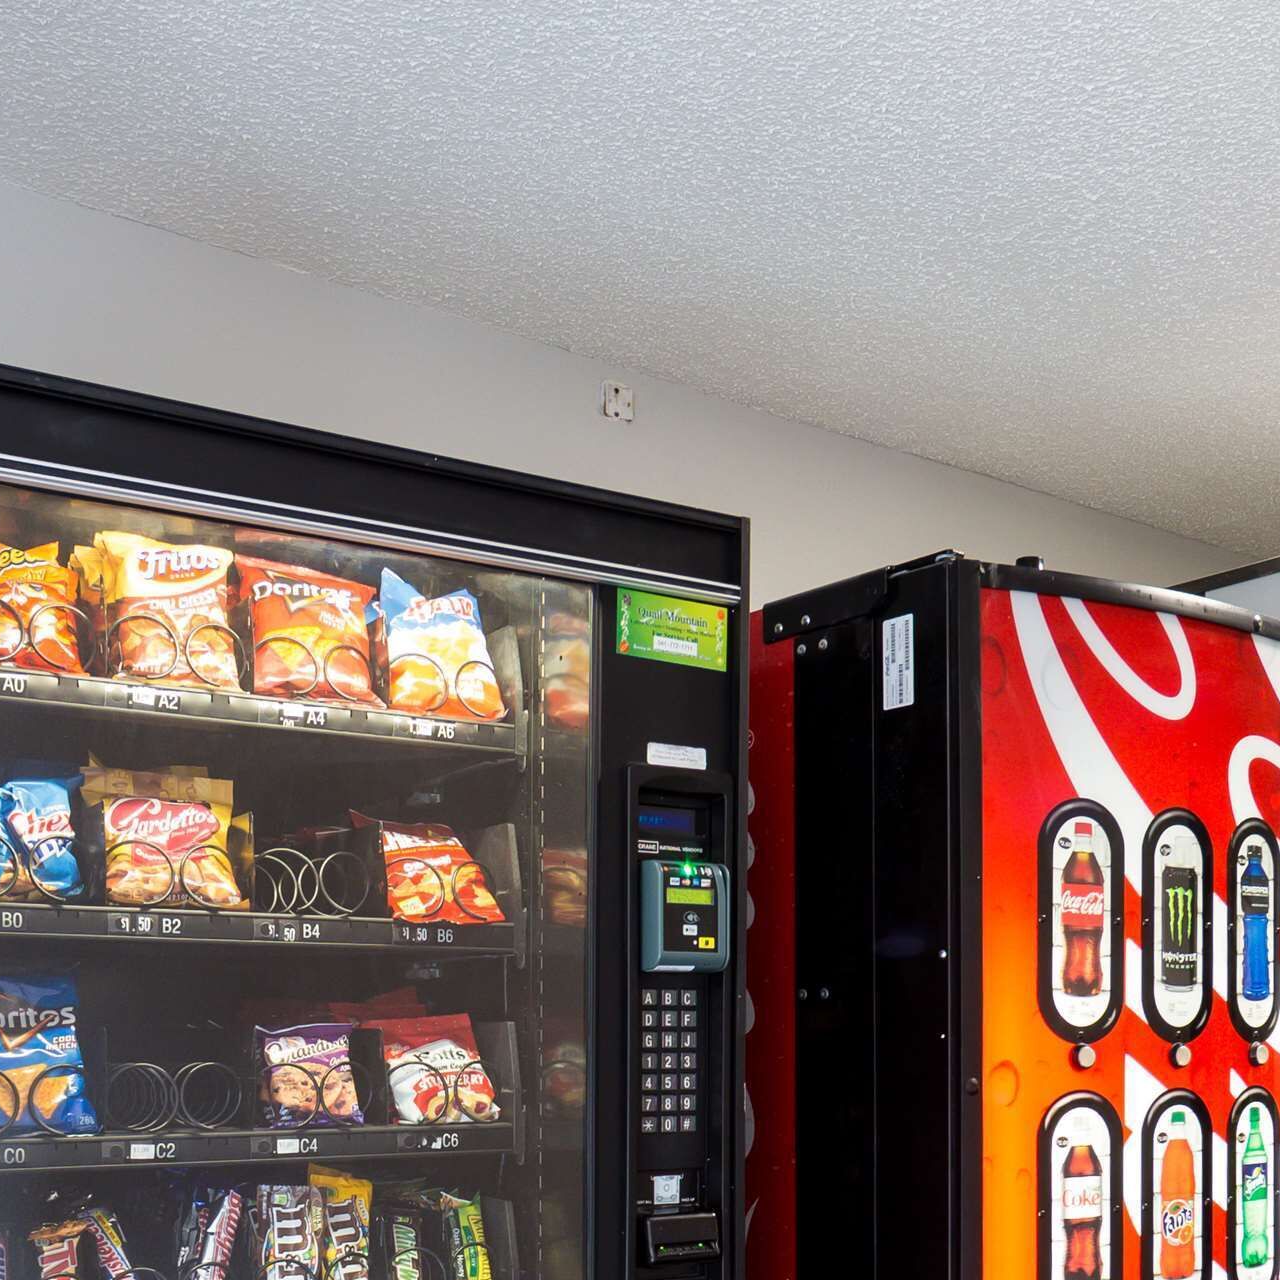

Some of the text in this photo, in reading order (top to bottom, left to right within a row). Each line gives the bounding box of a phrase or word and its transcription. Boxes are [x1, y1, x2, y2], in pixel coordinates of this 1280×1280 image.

[138, 550, 220, 579] Fritos
[252, 581, 354, 608] Doritos
[665, 610, 709, 629] Mountain
[2, 678, 25, 694] A0
[158, 695, 179, 711] A2
[307, 711, 326, 726] A4
[438, 725, 456, 740] A6
[108, 798, 219, 840] Gardetto's
[1062, 889, 1104, 916] Coca-Cola
[2, 913, 23, 929] B0
[162, 919, 182, 935] B2
[303, 923, 321, 939] B4
[437, 928, 454, 943] B6
[1163, 951, 1198, 964] MONSTER
[645, 992, 691, 1005] A B C
[645, 1014, 691, 1026] D E F
[52, 1034, 76, 1043] COOL
[645, 1035, 690, 1047] G H J
[647, 1056, 691, 1068] 1 2 3
[645, 1077, 691, 1089] 4 5 6
[645, 1098, 690, 1110] 7 8 9
[664, 1119, 671, 1131] 0
[300, 1138, 318, 1154] C4
[442, 1133, 459, 1148] C6
[4, 1148, 26, 1165] C0
[156, 1142, 176, 1159] C2
[1061, 1189, 1101, 1209] Coke
[456, 1253, 466, 1279] Honey
